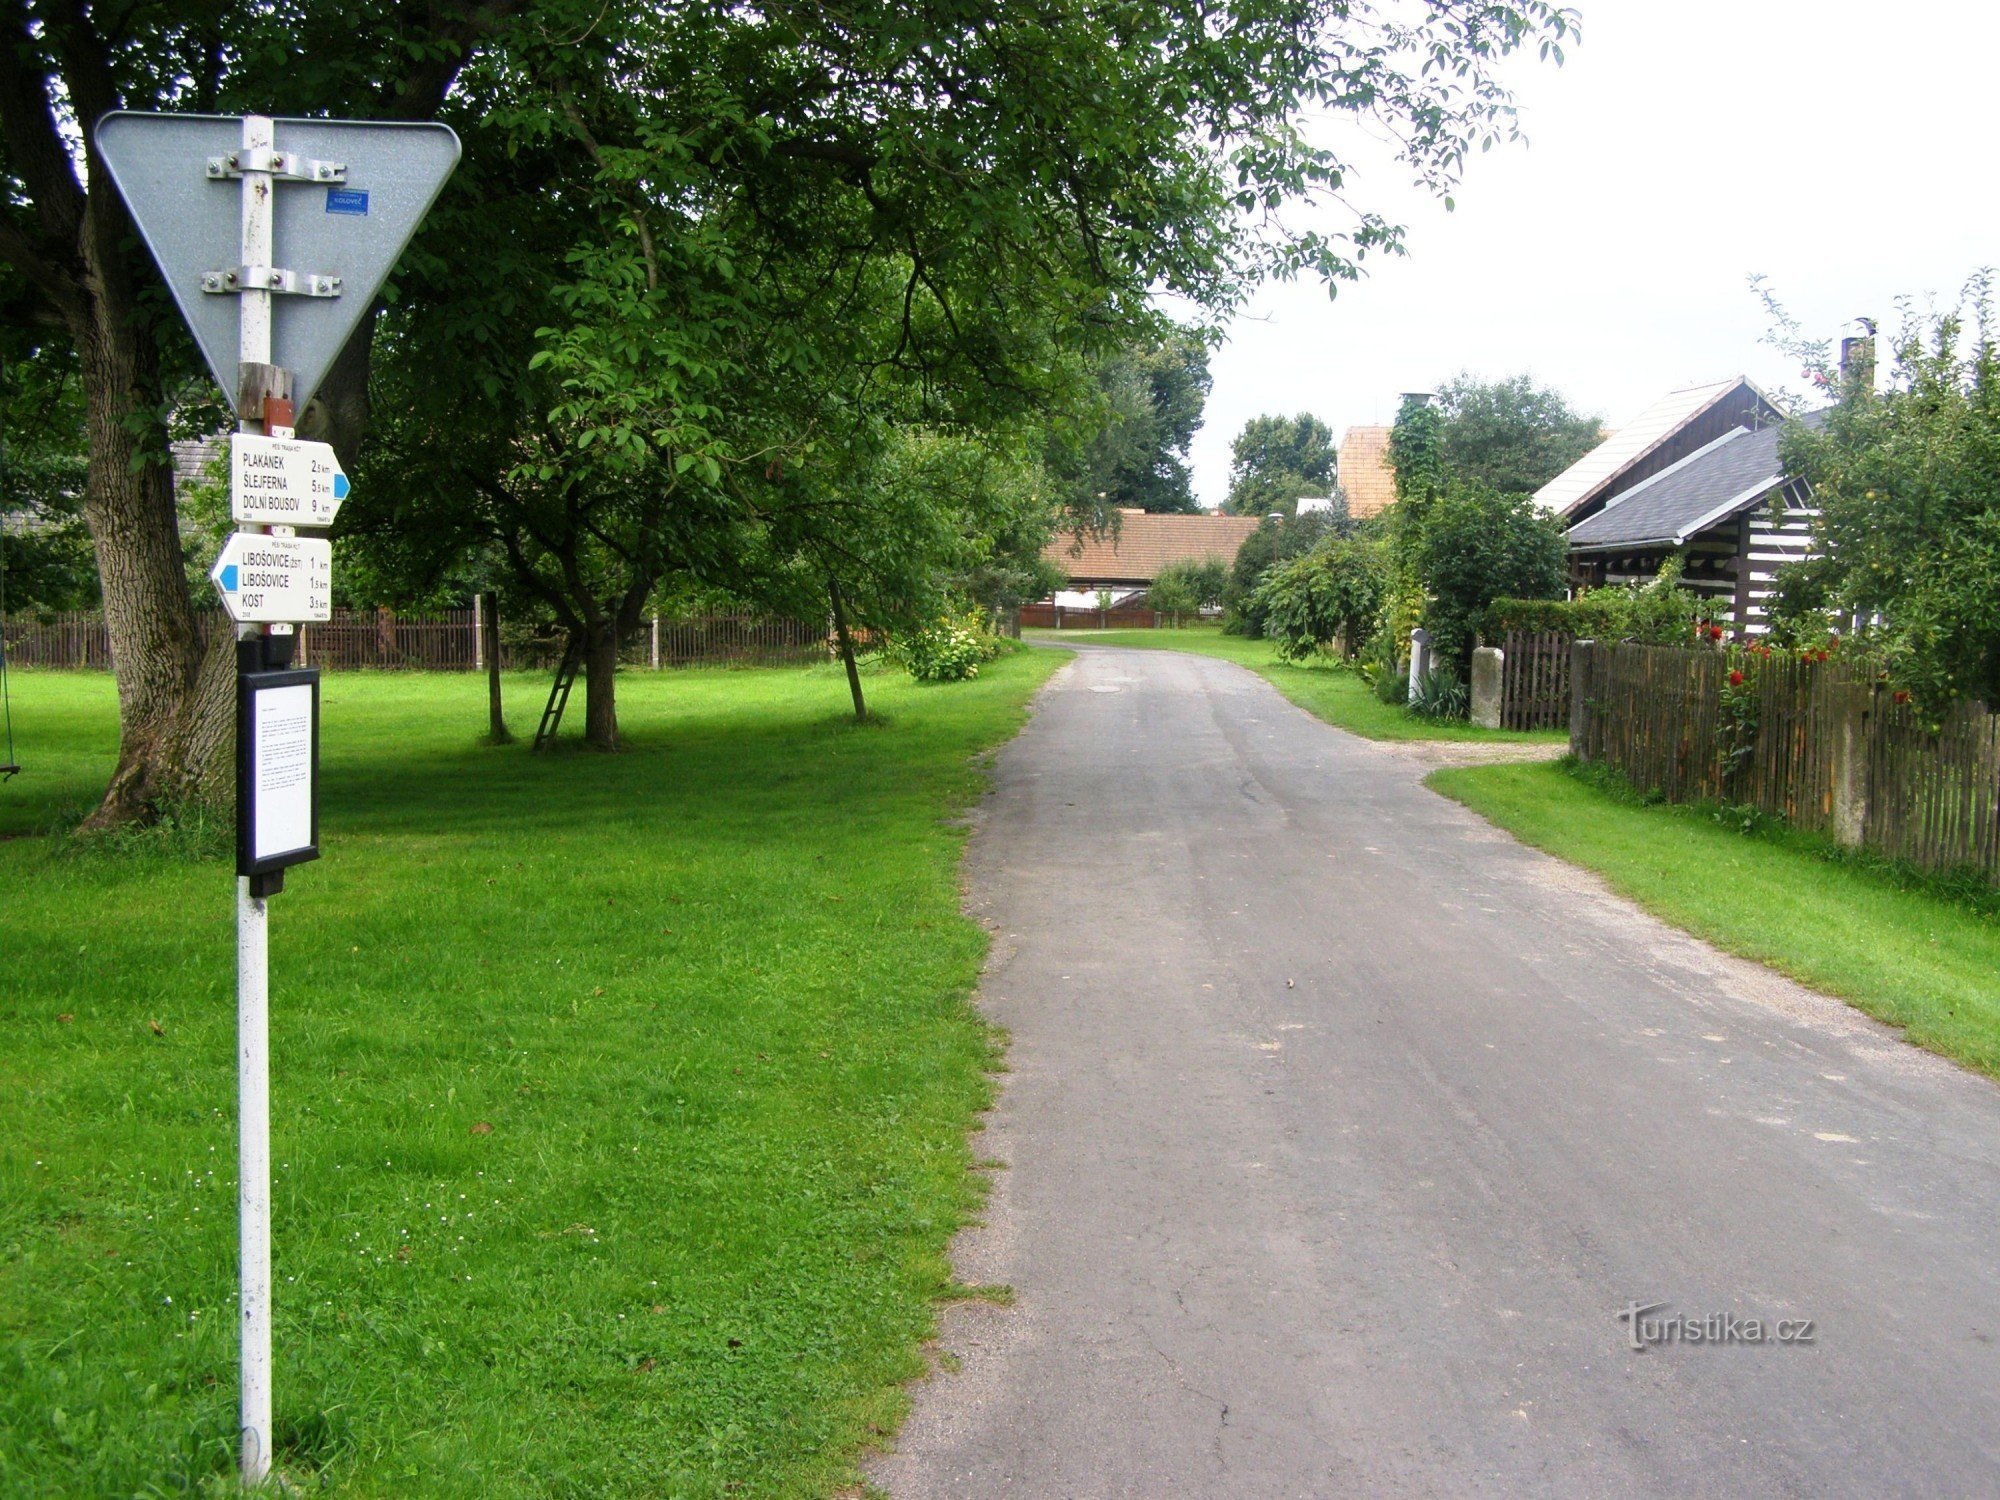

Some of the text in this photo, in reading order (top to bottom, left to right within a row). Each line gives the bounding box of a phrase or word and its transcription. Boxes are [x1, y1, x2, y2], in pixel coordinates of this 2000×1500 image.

[243, 452, 284, 469] PLAKÁNEK
[322, 465, 331, 474] km
[243, 471, 288, 490] ŠLEJFERNA
[322, 485, 331, 493] km
[243, 494, 331, 513] DOLNÍ BOUSOV 9 km
[242, 550, 290, 568] LIBOŠOVICE
[310, 556, 315, 569] 1
[320, 561, 328, 570] km
[242, 570, 289, 588] LIBOŠOVICE
[319, 581, 328, 589] km
[242, 594, 264, 608] KOST
[319, 601, 328, 609] km
